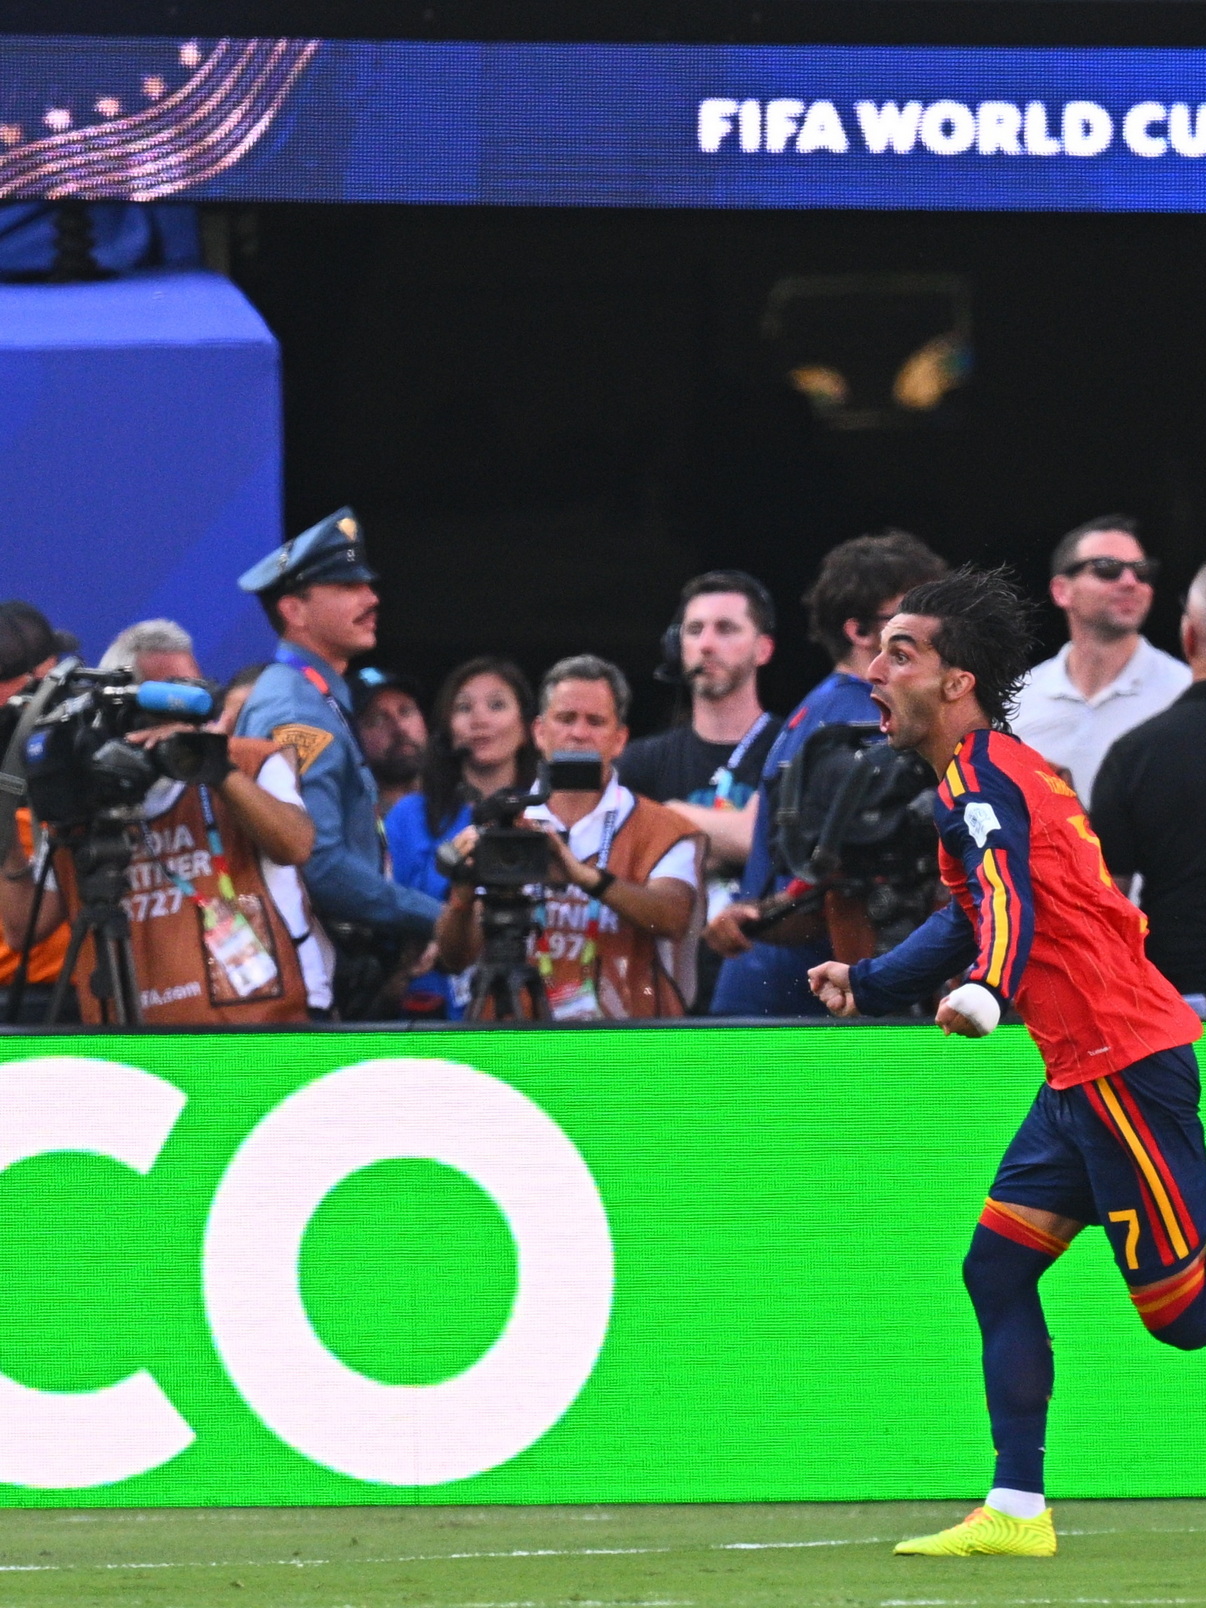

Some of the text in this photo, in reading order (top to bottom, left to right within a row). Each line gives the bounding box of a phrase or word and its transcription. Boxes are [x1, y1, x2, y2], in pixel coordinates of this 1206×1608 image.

[699, 99, 849, 154] FIFA
[854, 99, 1114, 157] WORLD
[1108, 1208, 1140, 1270] 7
